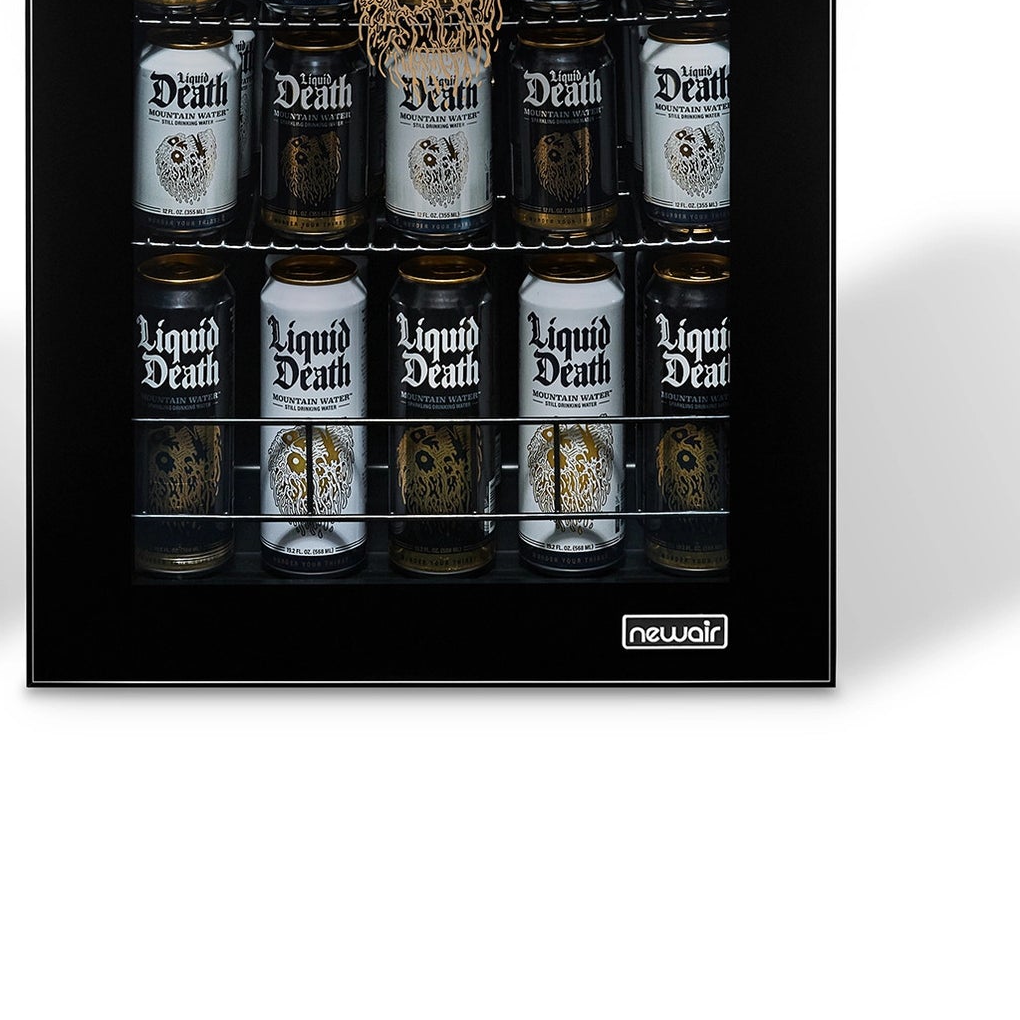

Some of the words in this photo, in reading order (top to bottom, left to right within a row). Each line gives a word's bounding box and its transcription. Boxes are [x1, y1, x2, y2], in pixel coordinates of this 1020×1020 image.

[176, 72, 209, 85] Liquid
[299, 73, 332, 86] Liquid
[549, 70, 582, 83] Liquid
[680, 65, 712, 78] Liquid
[148, 71, 229, 110] Death
[272, 71, 353, 111] Death
[522, 69, 602, 108] Death
[149, 109, 196, 119] MOUNTAIN
[198, 110, 227, 119] WATER
[523, 107, 570, 119] MOUNTAIN
[655, 102, 701, 113] MOUNTAIN
[400, 111, 446, 123] MOUNTAIN
[448, 112, 477, 122] WATER
[135, 313, 220, 364] Liquid
[267, 313, 351, 365] Liquid
[395, 311, 481, 363] Liquid
[527, 310, 611, 362] Liquid
[655, 312, 730, 362] Liqui
[141, 352, 220, 390] Death
[272, 351, 351, 391] Death
[400, 349, 481, 389] Death
[532, 348, 611, 388] Death
[661, 350, 730, 389] Deat
[272, 393, 318, 405] MOUNTAIN
[319, 393, 350, 405] WATER
[400, 391, 446, 403] MOUNTAIN
[447, 391, 478, 403] WATER
[533, 389, 578, 402] MOUNTAIN
[579, 389, 610, 401] WATER
[582, 400, 597, 408] WATER
[660, 391, 709, 403] MOUNTAIN
[321, 404, 336, 412] WATER
[629, 619, 721, 643] newair
